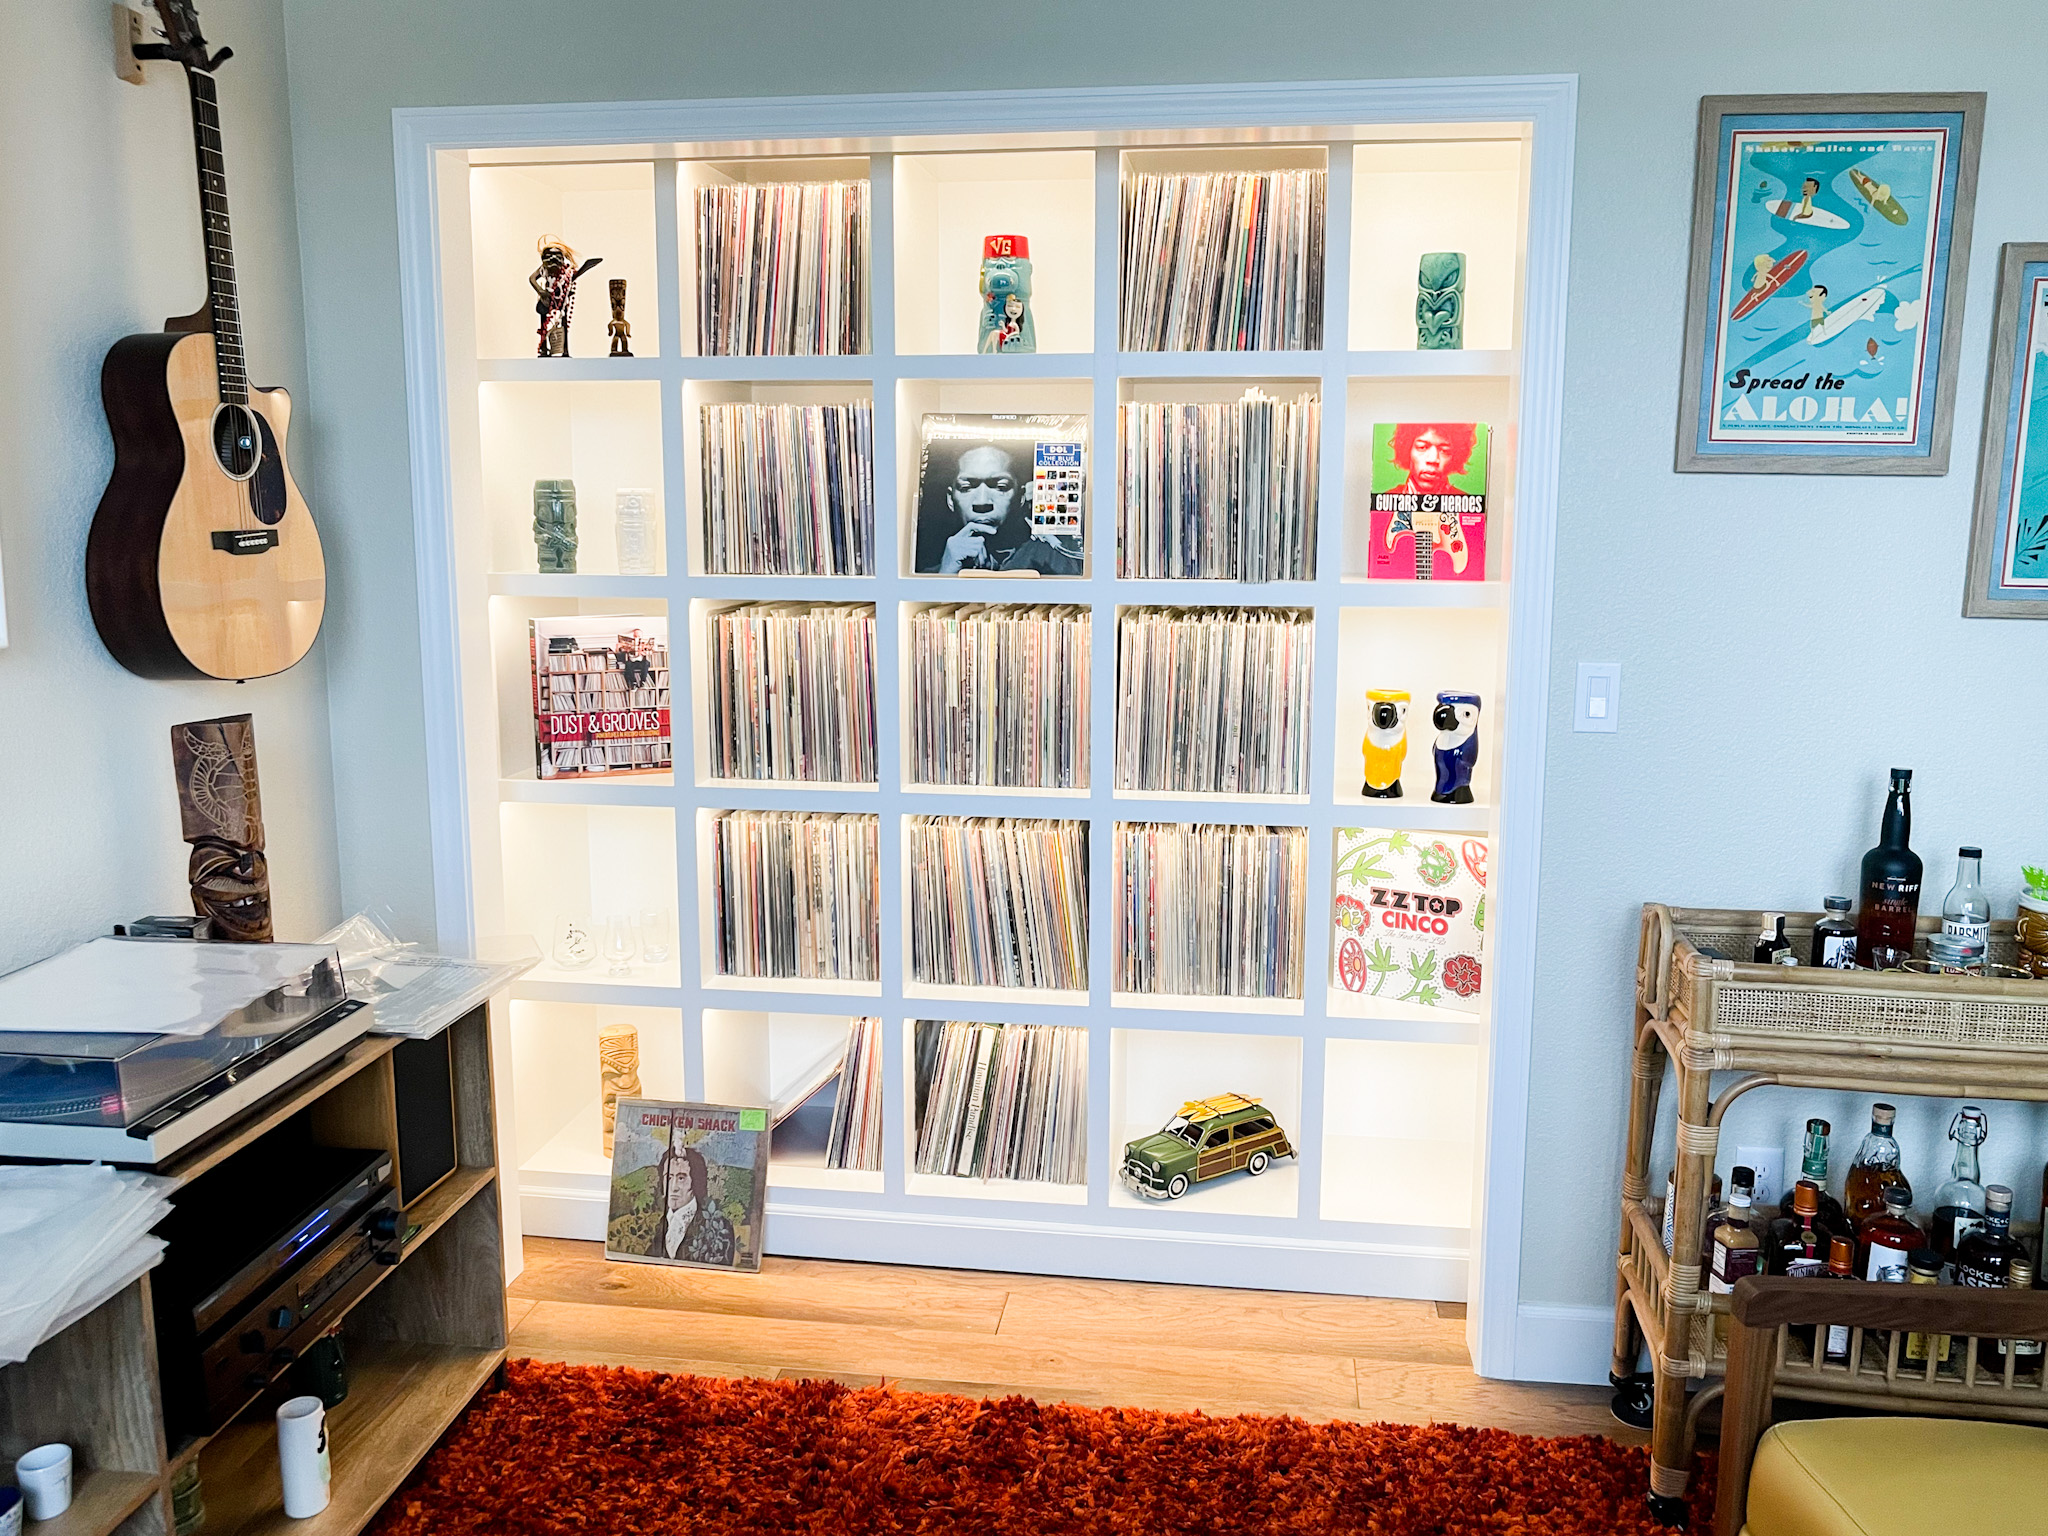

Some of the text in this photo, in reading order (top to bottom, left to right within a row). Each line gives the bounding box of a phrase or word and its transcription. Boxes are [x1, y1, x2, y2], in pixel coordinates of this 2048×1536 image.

[1806, 144, 1853, 153] Smiles
[1859, 144, 1885, 152] and
[990, 237, 1012, 256] VG
[1729, 369, 1845, 394] Spread the
[1723, 393, 1908, 423] ALOHA!
[1049, 446, 1068, 454] DOL
[1421, 493, 1440, 512] &
[550, 714, 585, 735] DUST
[588, 714, 601, 734] &
[602, 711, 660, 732] GROOVES
[1871, 881, 1919, 893] NEW RIFF
[1412, 892, 1463, 918] TOP
[1874, 903, 1913, 913] BARREL
[1382, 910, 1449, 936] CINCO
[641, 1113, 736, 1132] CHICKEN SHACK
[965, 1104, 980, 1141] Paradise
